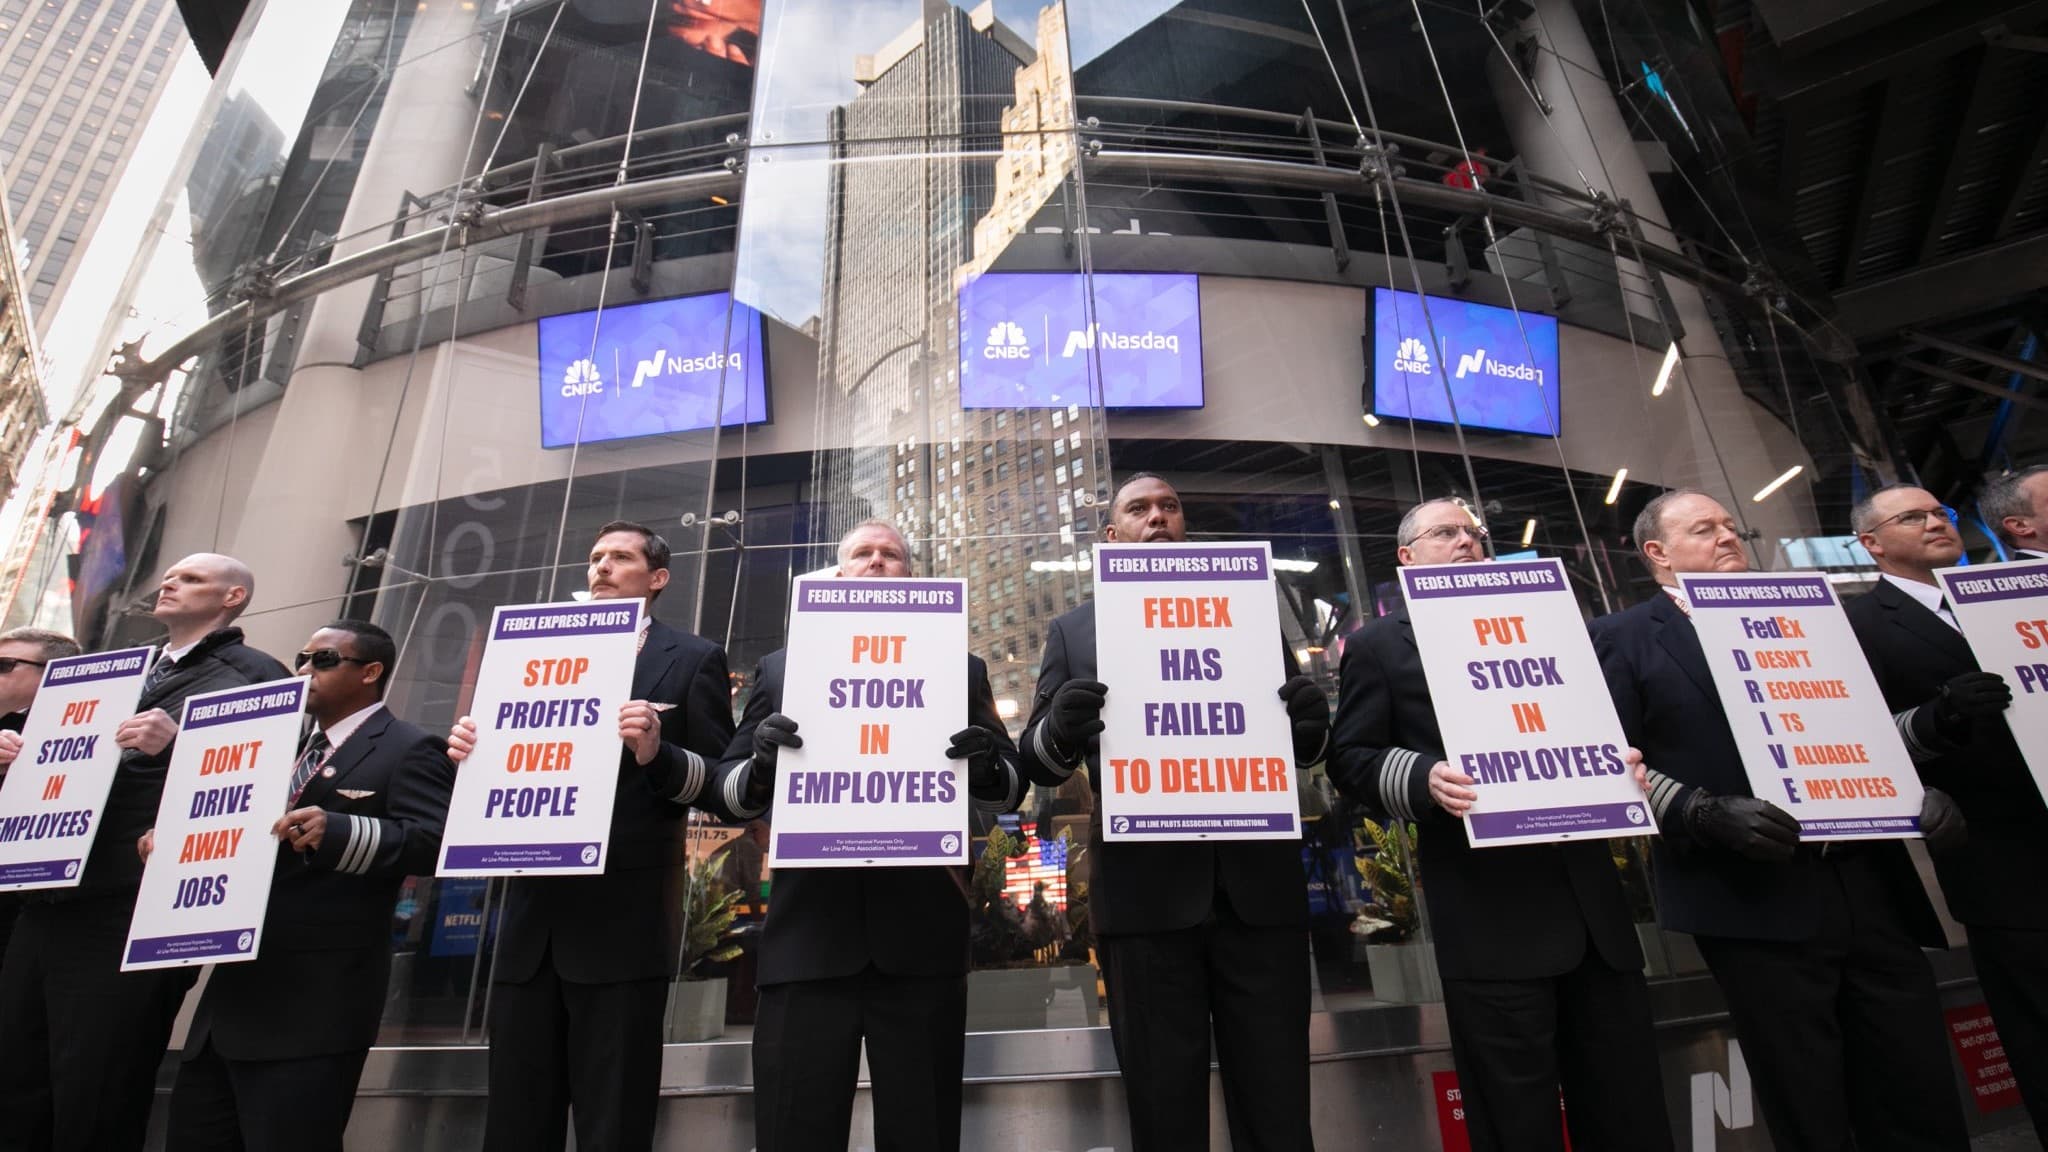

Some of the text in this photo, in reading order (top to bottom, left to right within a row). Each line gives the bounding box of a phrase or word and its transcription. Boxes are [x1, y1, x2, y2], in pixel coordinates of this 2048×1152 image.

[983, 330, 1179, 359] CNBC Nasdaq
[561, 352, 742, 398] CNBC Nasdaq
[1394, 359, 1543, 387] CNBC Nasdaq
[1108, 556, 1259, 573] FEDEX EXPRESS PILOTS
[1414, 569, 1556, 591] FEDEX EXPRESS PILOTS
[1693, 585, 1824, 600] FEDEX EXPRESS PILOTS
[1955, 573, 2048, 595] FEDEX EXPRESS
[807, 589, 954, 605] FEDEX EXPRESS PILOTS
[502, 611, 631, 632] FEDEX EXPRESS PILOTS
[1143, 597, 1233, 629] FEDEX
[1740, 616, 1805, 639] FedEx
[1473, 616, 1528, 646] PUT
[852, 635, 907, 664] PUT
[1160, 647, 1223, 681] HAS
[1732, 649, 1812, 672] D OESN'T
[50, 656, 142, 680] FEDEX EXPRESS PILOTS
[523, 657, 589, 688] STOP
[1467, 656, 1565, 691] STOCK
[190, 690, 297, 722] FEDEX EXPRESS PILOTS
[829, 678, 925, 709] STOCK
[1744, 680, 1849, 703] R ECOGNIZE
[61, 699, 100, 727] PUT
[495, 697, 601, 730] PROFITS
[1144, 702, 1246, 736] FAILED
[1511, 702, 1547, 733] IN
[1759, 711, 1805, 736] I TS
[36, 734, 100, 765] STOCK
[859, 724, 890, 755] IN
[200, 741, 263, 776] DON'T
[506, 742, 574, 773] OVER
[1460, 743, 1626, 785] EMPLOYEES
[1767, 743, 1869, 769] V ALUABLE
[42, 774, 66, 801] IN
[787, 770, 957, 804] EMPLOYEES
[1109, 757, 1289, 794] TO DELIVER
[1782, 777, 1898, 804] E MPLOYEES
[189, 784, 254, 819] DRIVE
[485, 786, 579, 818] PEOPLE
[1135, 820, 1147, 828] AIR
[1147, 819, 1160, 828] LINE
[1160, 819, 1181, 828] PILOTS
[1223, 818, 1269, 827] INTERNATIONAL
[179, 828, 244, 864] AWAY
[172, 874, 228, 909] JOBS
[444, 913, 481, 927] NETFLI
